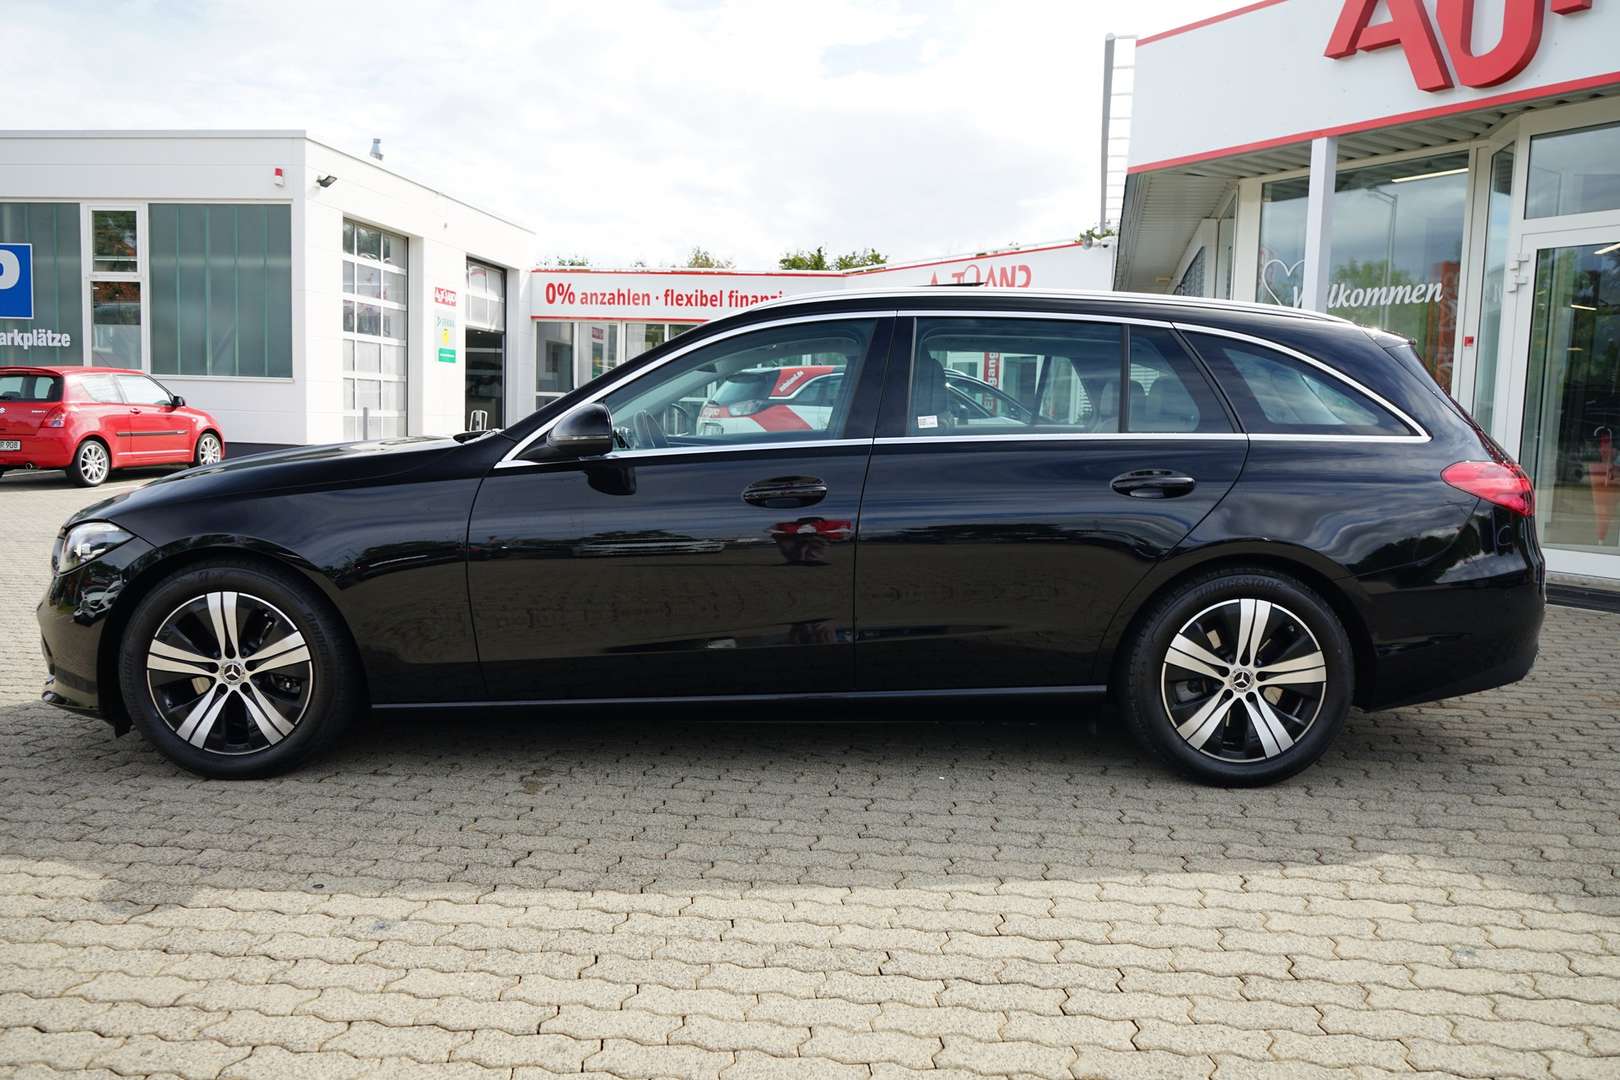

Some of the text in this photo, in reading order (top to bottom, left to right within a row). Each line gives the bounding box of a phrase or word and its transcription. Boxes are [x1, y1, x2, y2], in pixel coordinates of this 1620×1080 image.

[545, 282, 576, 305] 0%
[580, 288, 651, 306] anzahlen
[664, 288, 723, 307] flexibel
